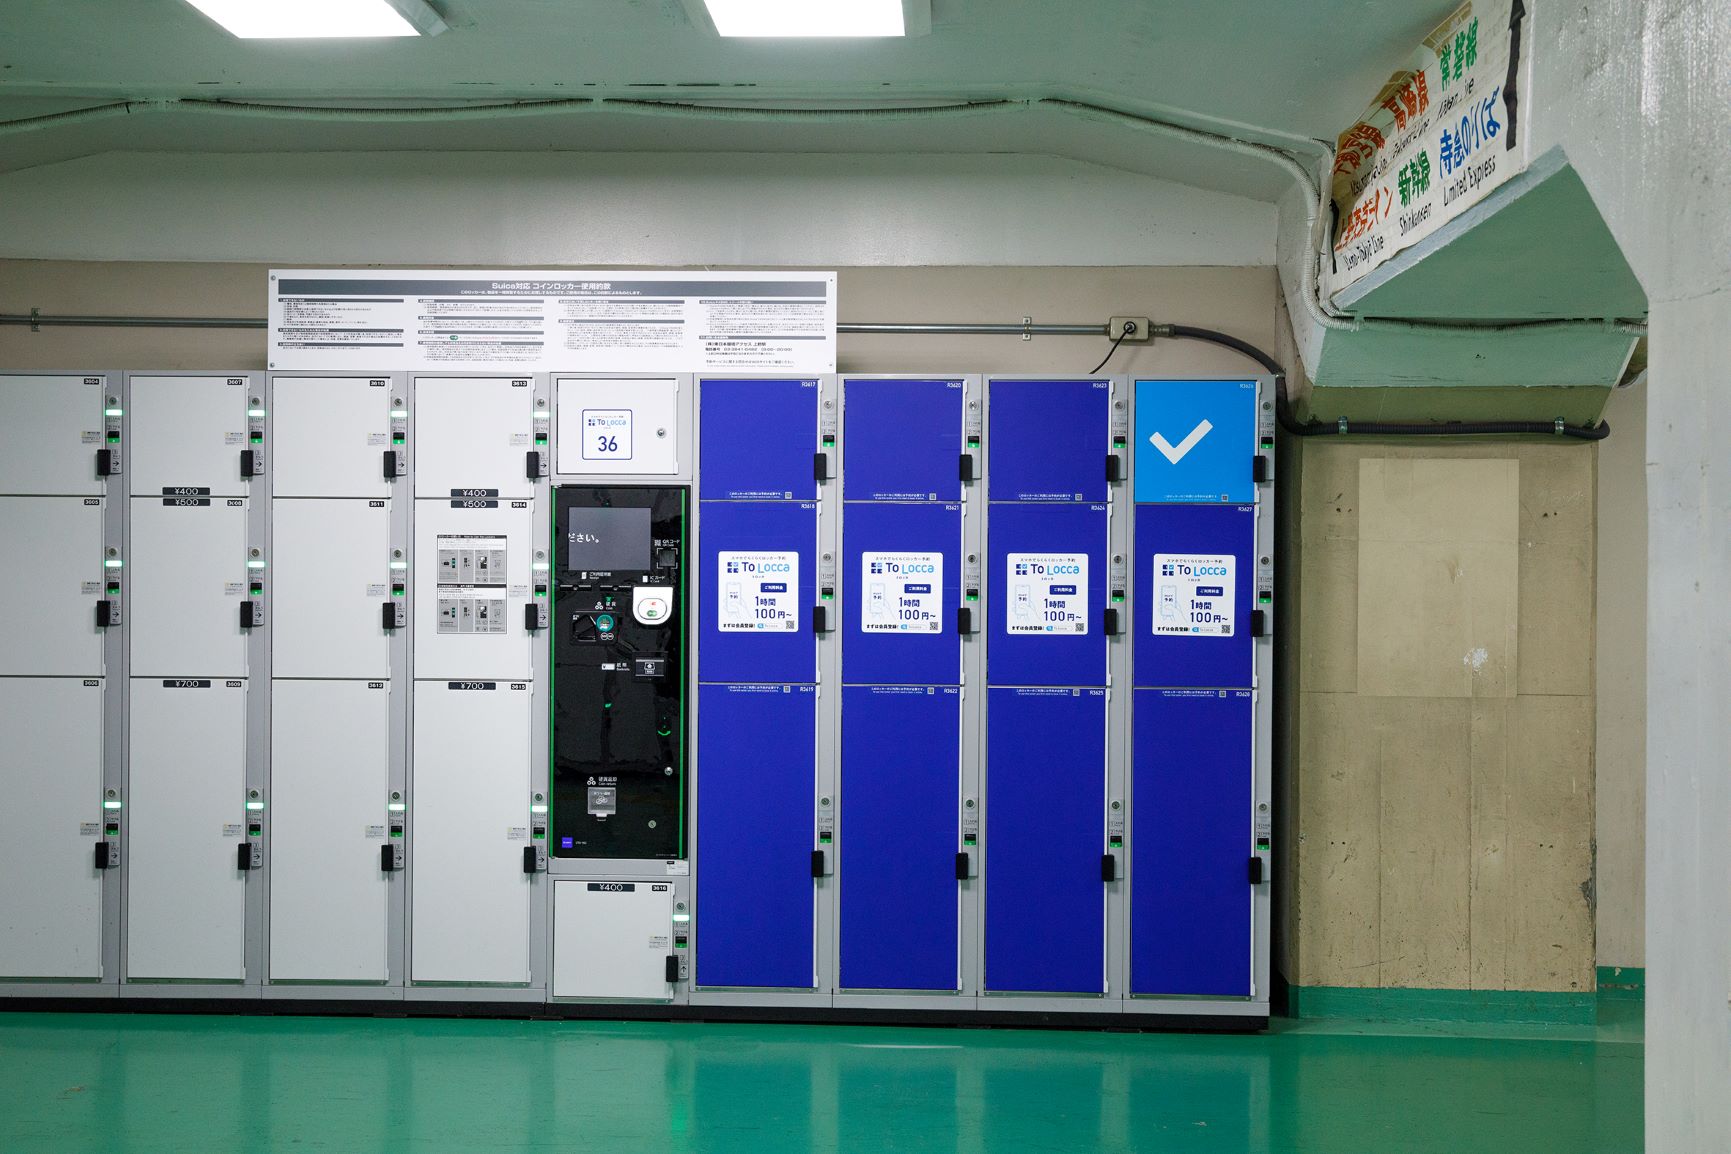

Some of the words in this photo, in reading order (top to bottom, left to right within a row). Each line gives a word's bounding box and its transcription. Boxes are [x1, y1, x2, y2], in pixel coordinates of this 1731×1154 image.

[1467, 155, 1496, 190] Express
[491, 282, 531, 291] Suica対応
[597, 418, 606, 426] To
[606, 419, 627, 427] Locca
[598, 435, 618, 452] 36
[463, 489, 487, 497] ¥400
[463, 500, 486, 508] ¥500
[742, 562, 755, 572] To
[758, 562, 790, 574] Locca
[886, 562, 899, 573] To
[902, 564, 934, 574] Locca
[1030, 564, 1044, 574] To
[1047, 565, 1080, 576] Locca
[1177, 565, 1191, 575] To
[1194, 566, 1227, 577] Locca
[755, 596, 776, 606] 1時間
[899, 597, 920, 608] 1時間
[1044, 598, 1066, 609] 1時間
[1190, 600, 1212, 610] 1時間
[461, 682, 484, 690] ¥700
[599, 883, 623, 891] ¥400
